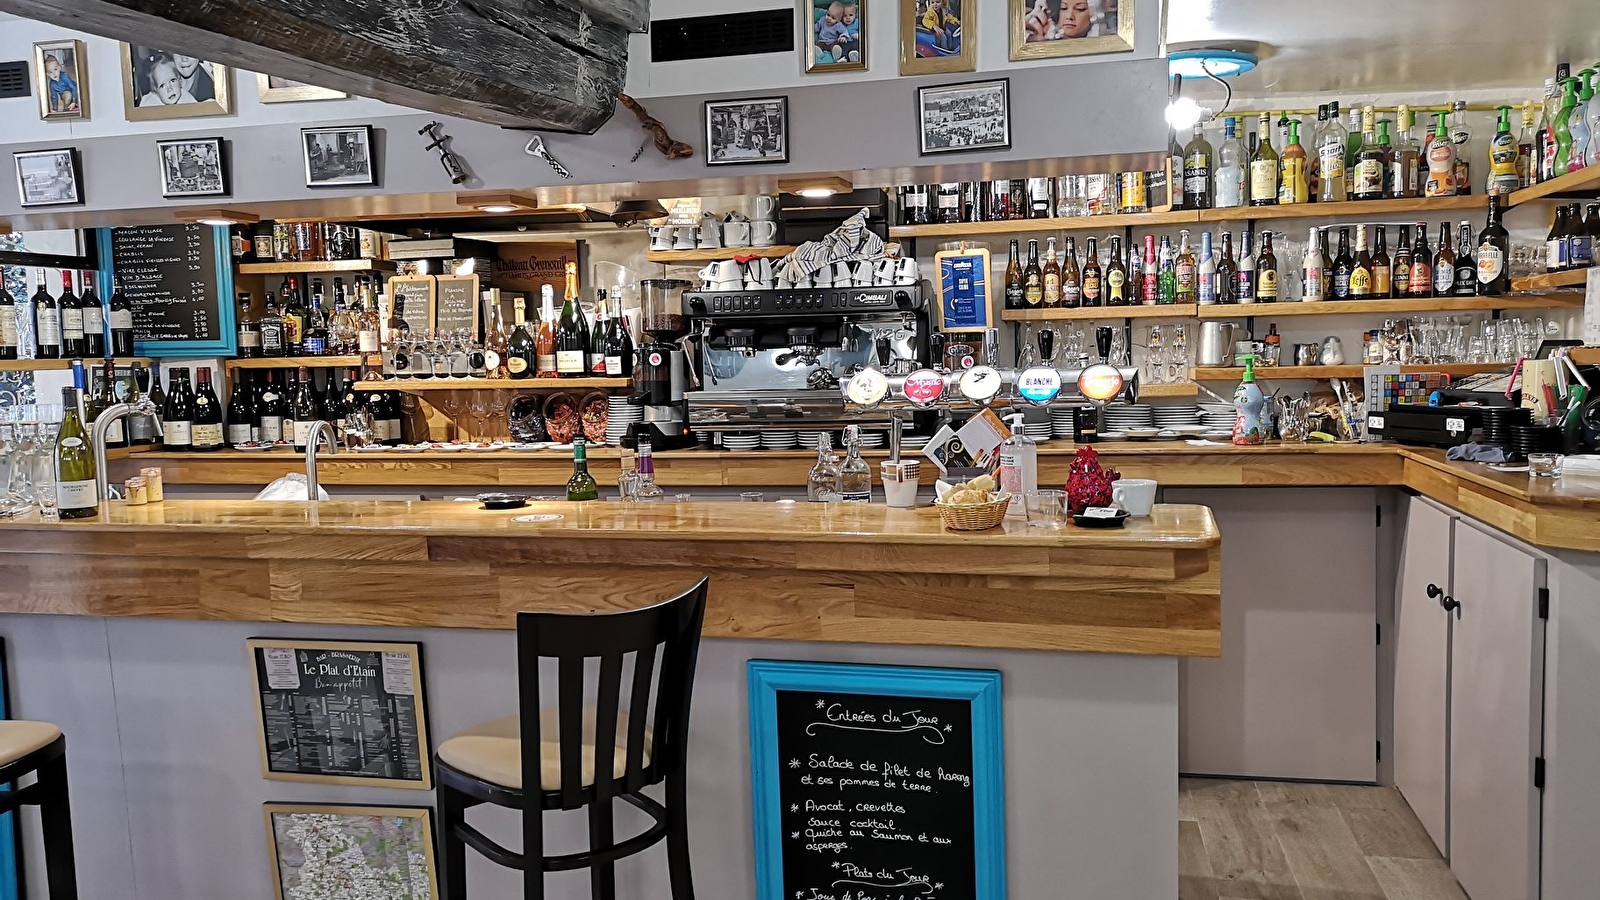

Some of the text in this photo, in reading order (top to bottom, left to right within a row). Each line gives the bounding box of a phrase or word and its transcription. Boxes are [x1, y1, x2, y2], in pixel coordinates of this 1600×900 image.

[1025, 377, 1053, 386] BLANCHE
[303, 663, 316, 675] Le
[319, 664, 340, 676] Plat
[826, 703, 939, 729] Entrées du Jour
[808, 753, 855, 770] Salade
[860, 760, 878, 772] de
[881, 761, 911, 781] filet
[916, 768, 933, 779] de
[801, 774, 814, 785] et
[817, 777, 834, 786] ses
[839, 777, 880, 791] pommes
[884, 780, 897, 788] de
[855, 802, 907, 814] crevettes
[805, 829, 843, 842] Quiche
[849, 829, 865, 837] au
[918, 832, 929, 843] et
[841, 862, 930, 884] Plats du Jour
